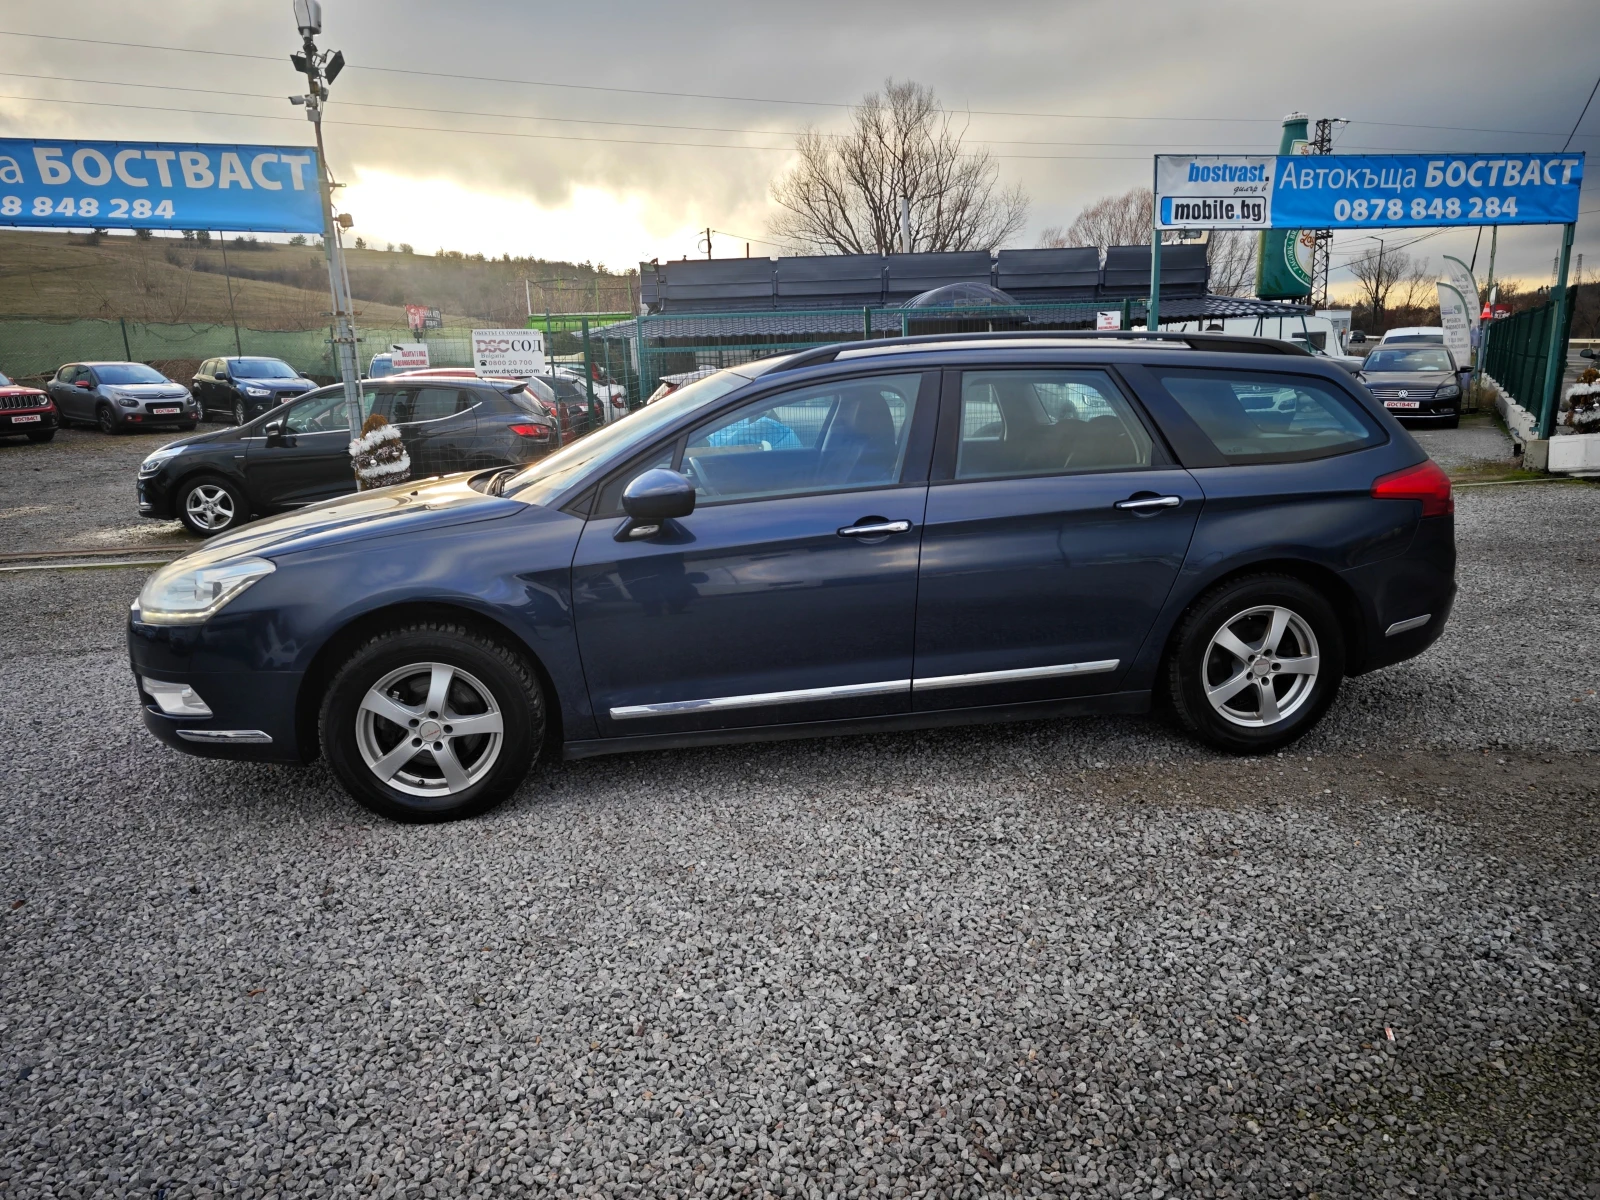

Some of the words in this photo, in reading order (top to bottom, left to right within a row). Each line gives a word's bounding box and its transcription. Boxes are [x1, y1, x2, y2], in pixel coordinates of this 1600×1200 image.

[32, 147, 311, 191] БОСТВАСТ
[1188, 162, 1270, 183] bostvast.
[1279, 161, 1417, 194] Автокъща
[1424, 159, 1579, 188] БОСТВАСТ
[31, 196, 100, 217] 848
[108, 198, 176, 219] 284
[1174, 199, 1262, 222] mobile.bg
[1333, 198, 1403, 221] 0878
[1411, 197, 1462, 220] 848
[1468, 196, 1518, 218] 284
[1287, 240, 1299, 271] ZAGORKA
[475, 339, 510, 353] DSC
[511, 339, 543, 354] СОД
